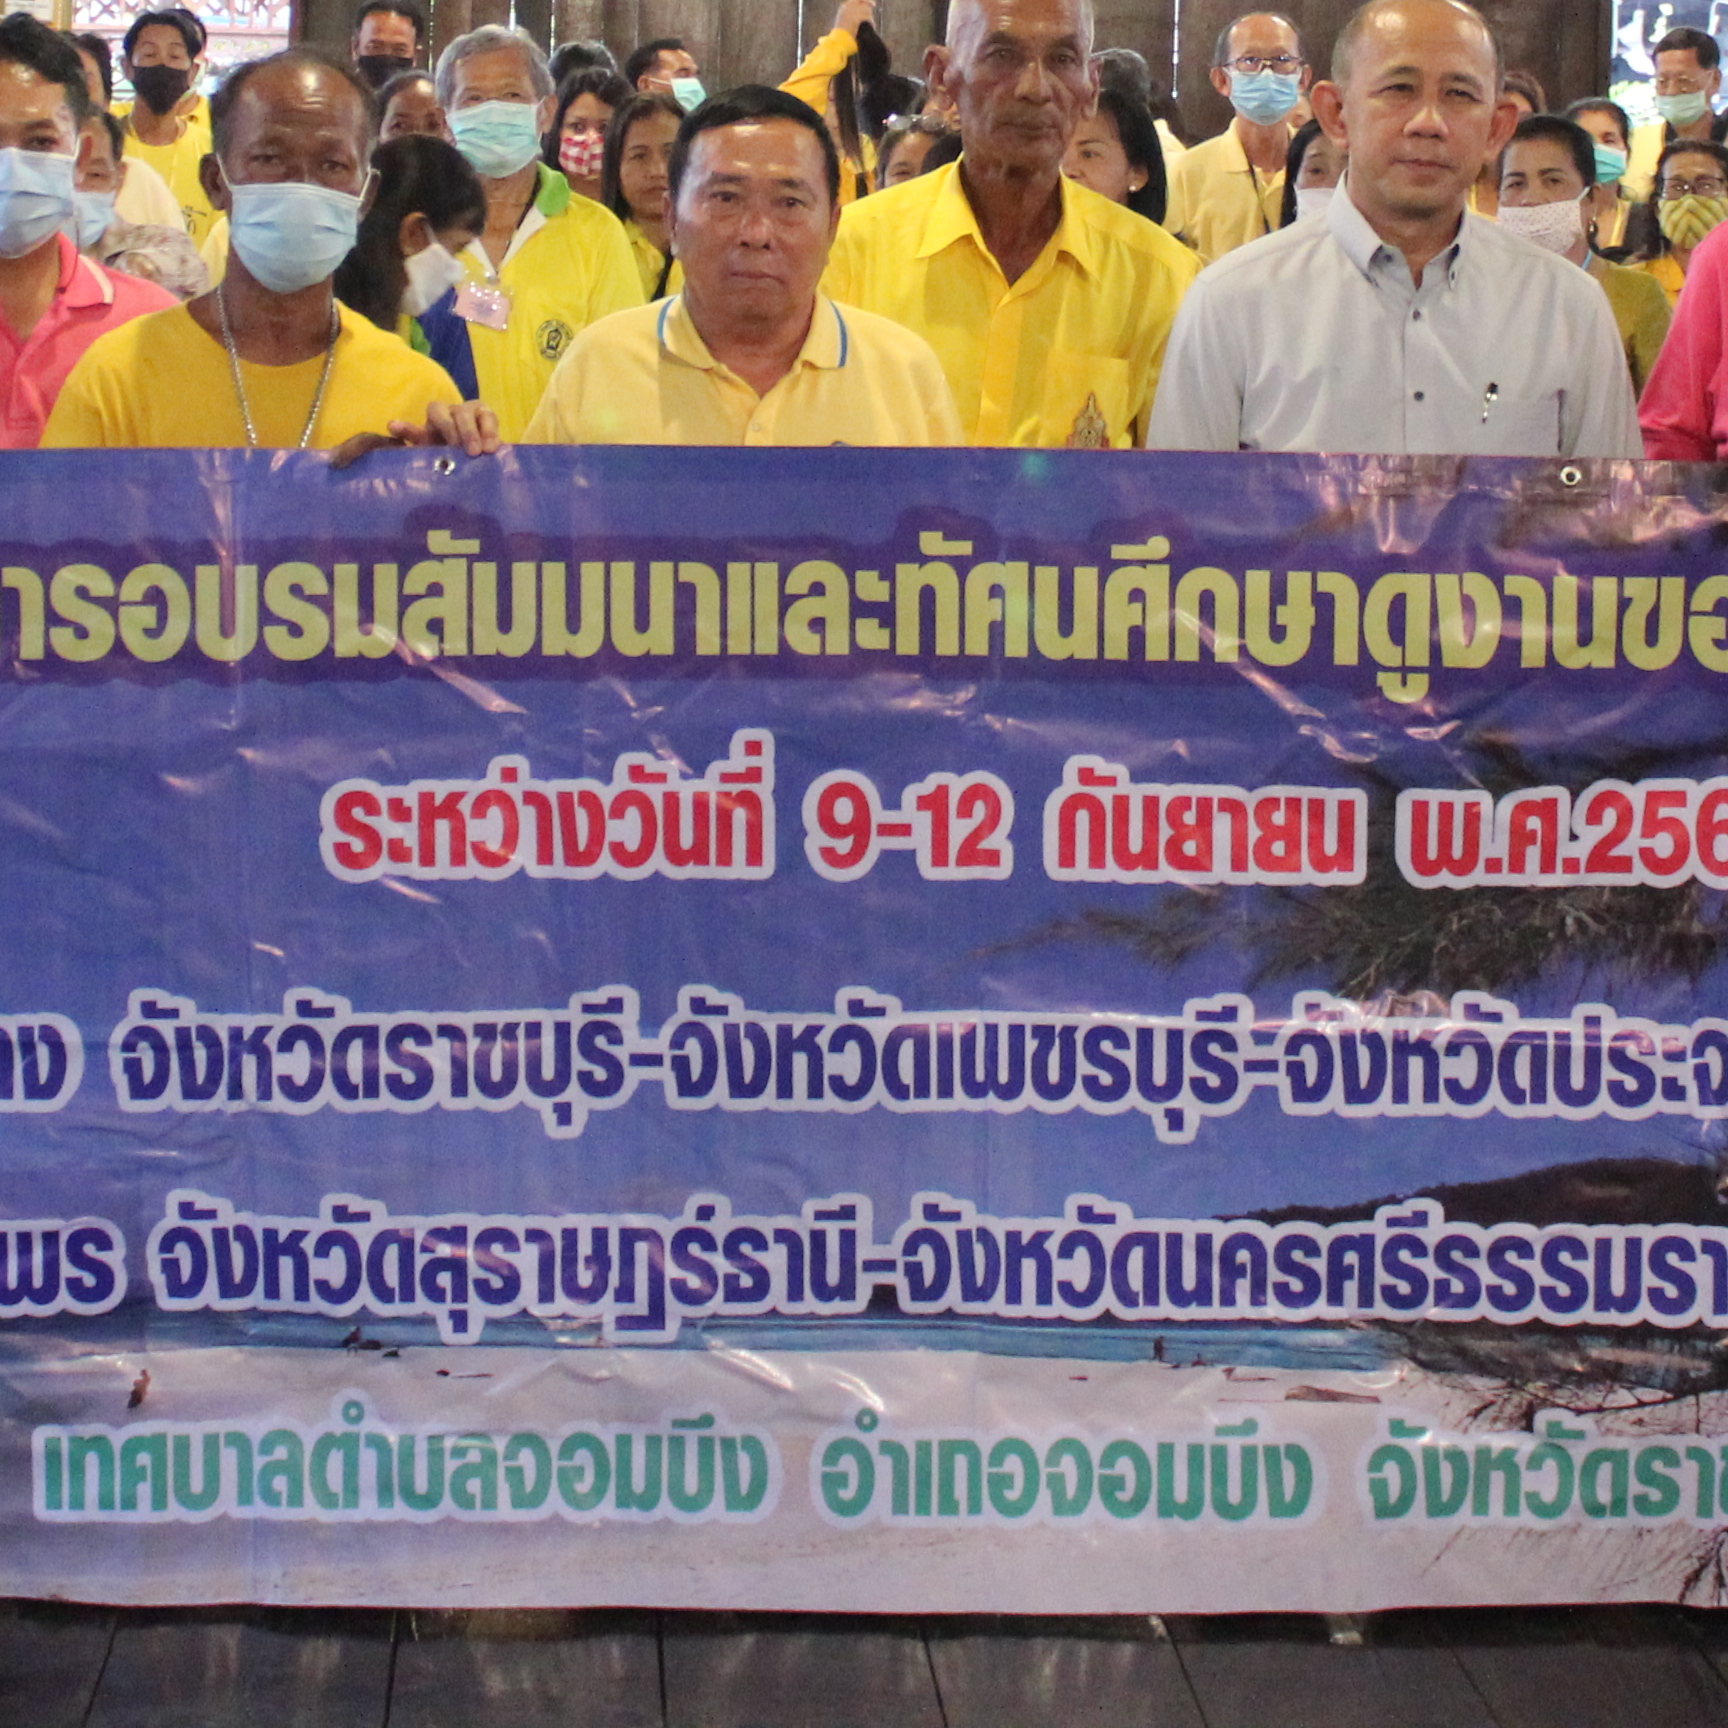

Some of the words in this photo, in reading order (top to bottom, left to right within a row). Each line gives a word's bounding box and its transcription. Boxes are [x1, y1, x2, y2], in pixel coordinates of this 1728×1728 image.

[334, 740, 763, 869] ระหว่างวันที่
[817, 781, 1003, 870] 9-12
[1059, 766, 1356, 874] กันยายน
[44, 1402, 768, 1514] เทศบาลตำบลจอมบึง
[821, 1408, 1313, 1520] อำเภอจอมบึง
